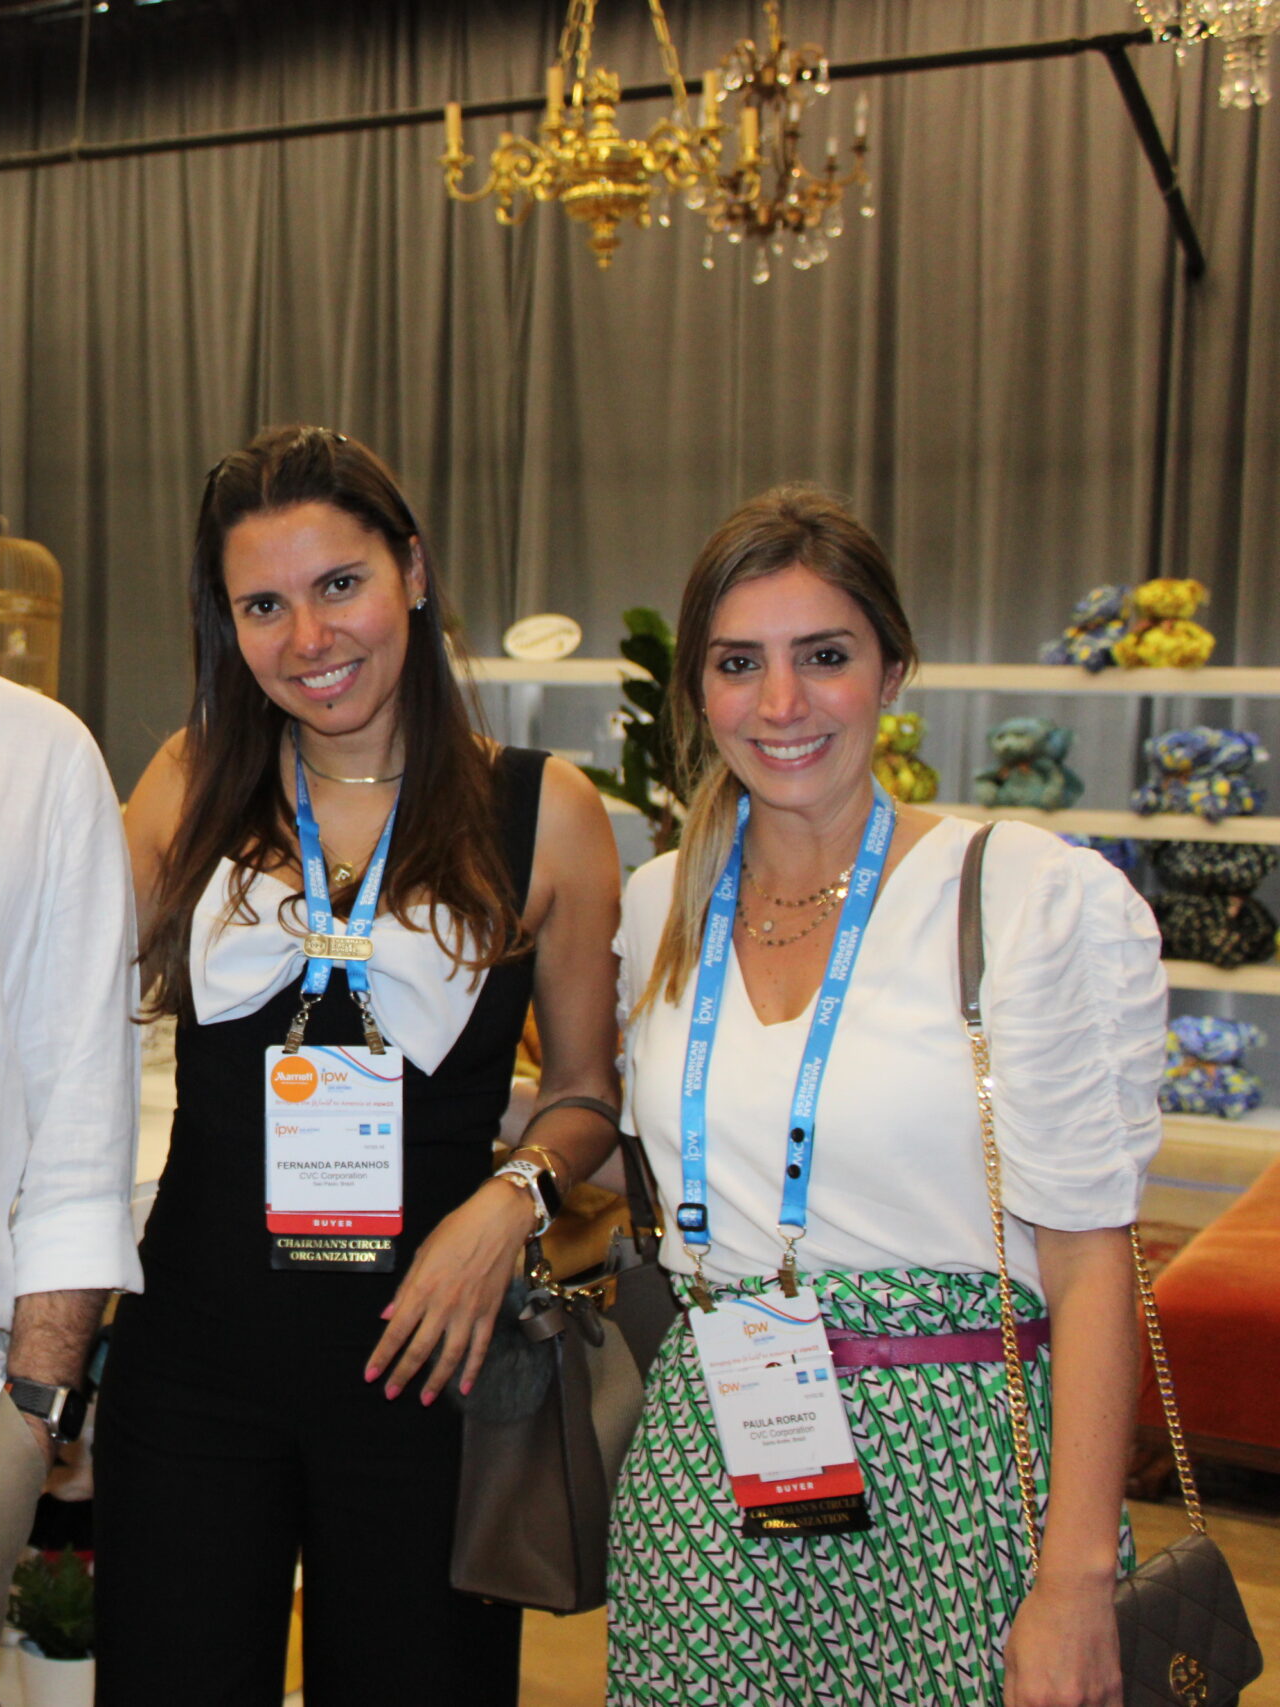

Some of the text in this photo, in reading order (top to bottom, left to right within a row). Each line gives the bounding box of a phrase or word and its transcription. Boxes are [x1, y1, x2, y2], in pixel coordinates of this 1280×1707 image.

[856, 867, 877, 897] ipw
[693, 996, 713, 1024] ipw
[818, 996, 840, 1025] ipw
[274, 1072, 313, 1082] Marriott
[321, 1068, 349, 1085] ipw
[275, 1122, 299, 1137] ipw
[683, 1130, 701, 1161] ipw
[277, 1161, 389, 1170] FERNANDA PARANHOS
[299, 1172, 368, 1181] CVC Corporation
[313, 1219, 353, 1228] BUYER
[277, 1239, 391, 1250] CHAIRMAN'S CIRCLE
[290, 1251, 377, 1262] ORGANIZATION
[742, 1320, 769, 1339] ipw
[718, 1380, 740, 1396] ipw
[742, 1411, 817, 1430] PAULA RORATO
[750, 1424, 816, 1440] CVC Corporation
[775, 1481, 815, 1494] BUYER
[762, 1512, 849, 1529] ORGANIZATION
